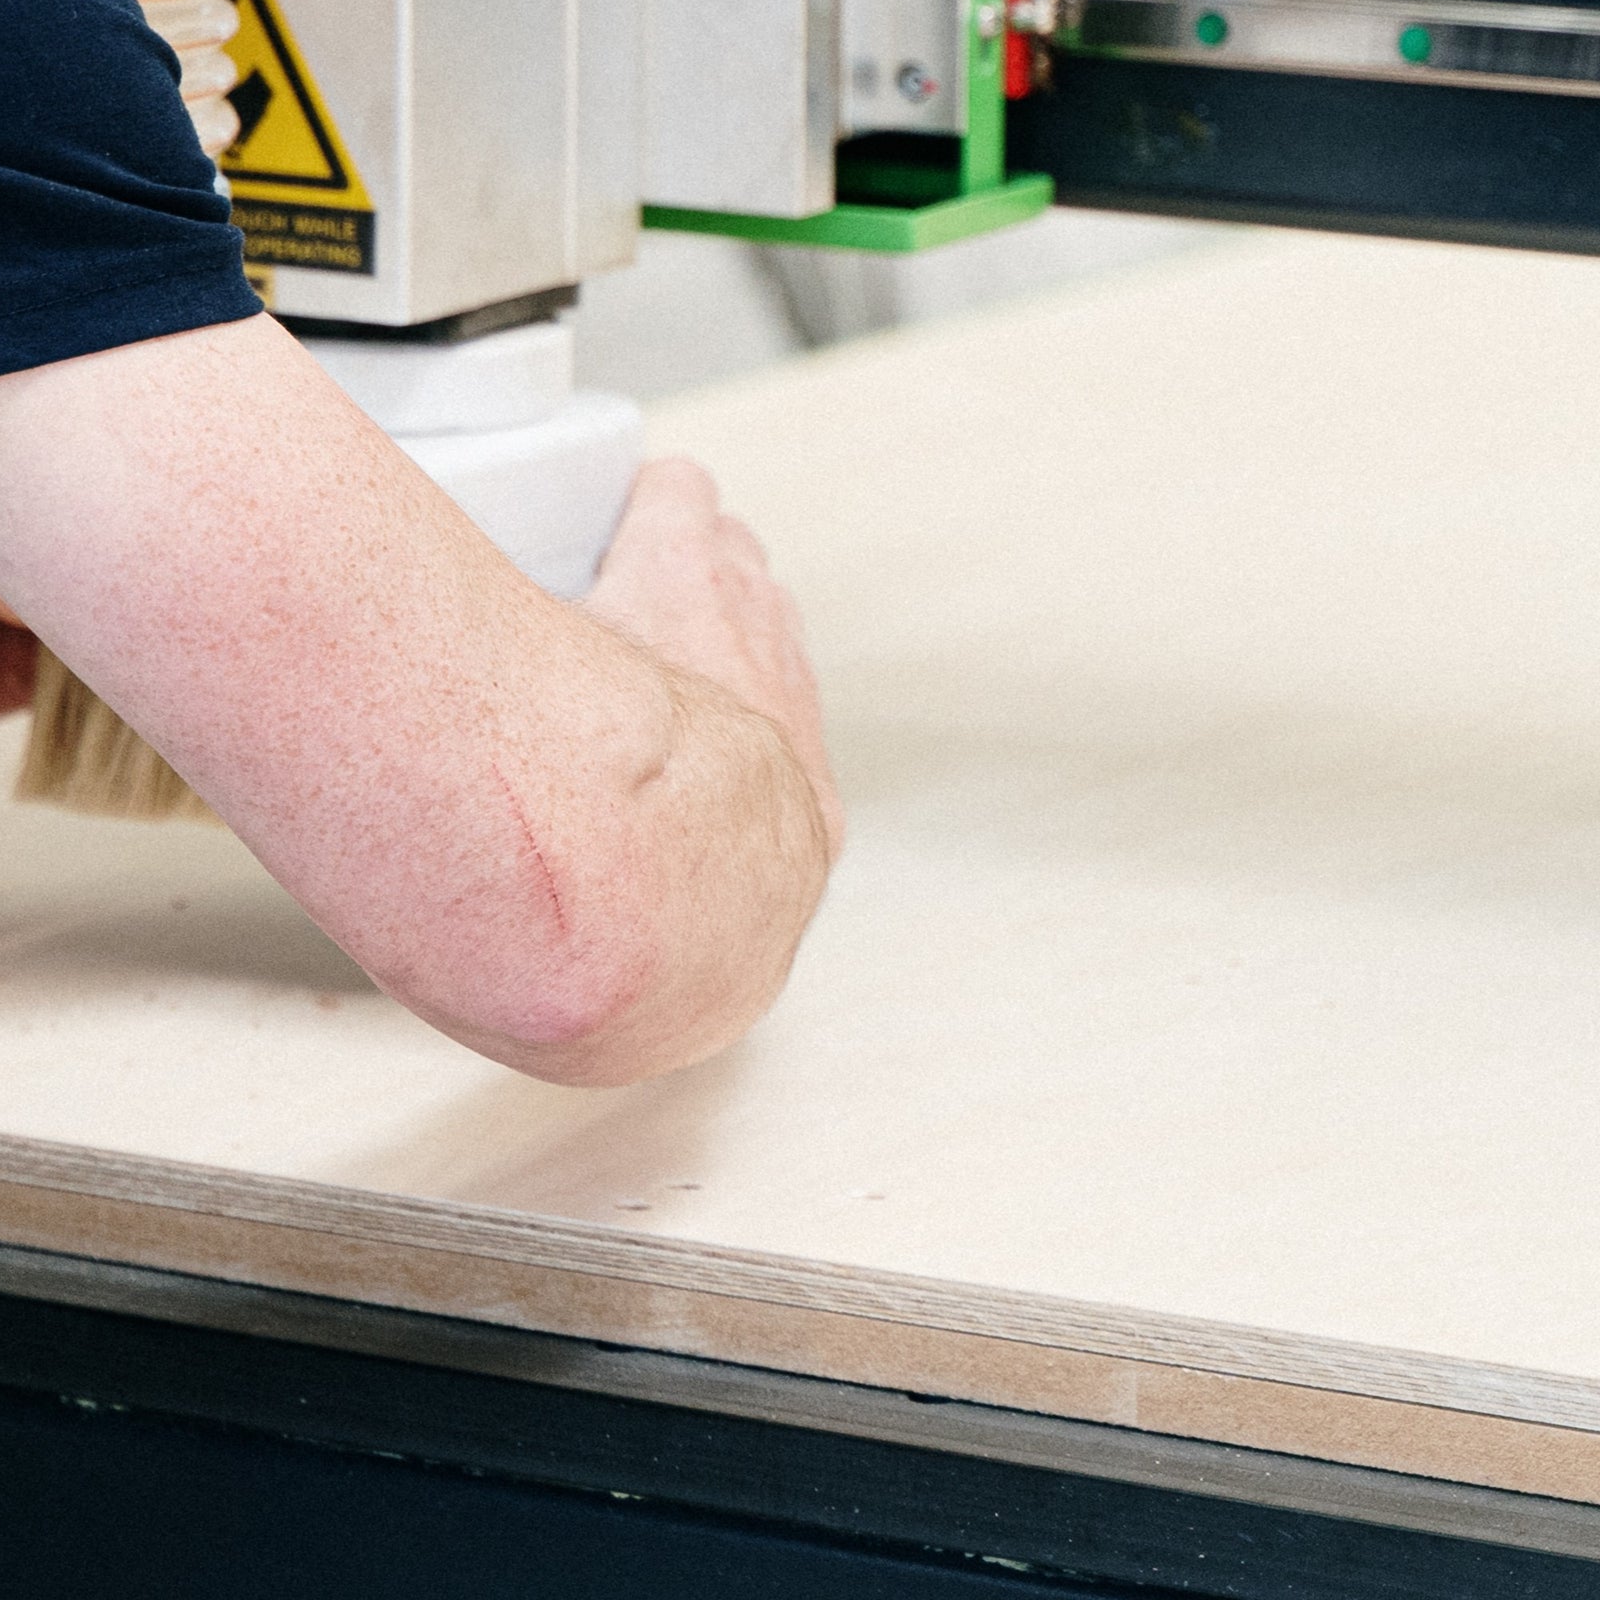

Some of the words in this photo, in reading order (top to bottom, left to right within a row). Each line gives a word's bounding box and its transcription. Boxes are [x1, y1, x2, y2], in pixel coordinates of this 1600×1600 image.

[231, 209, 287, 230] OUCH
[293, 215, 357, 239] WHILE
[244, 236, 361, 266] OPERATING
